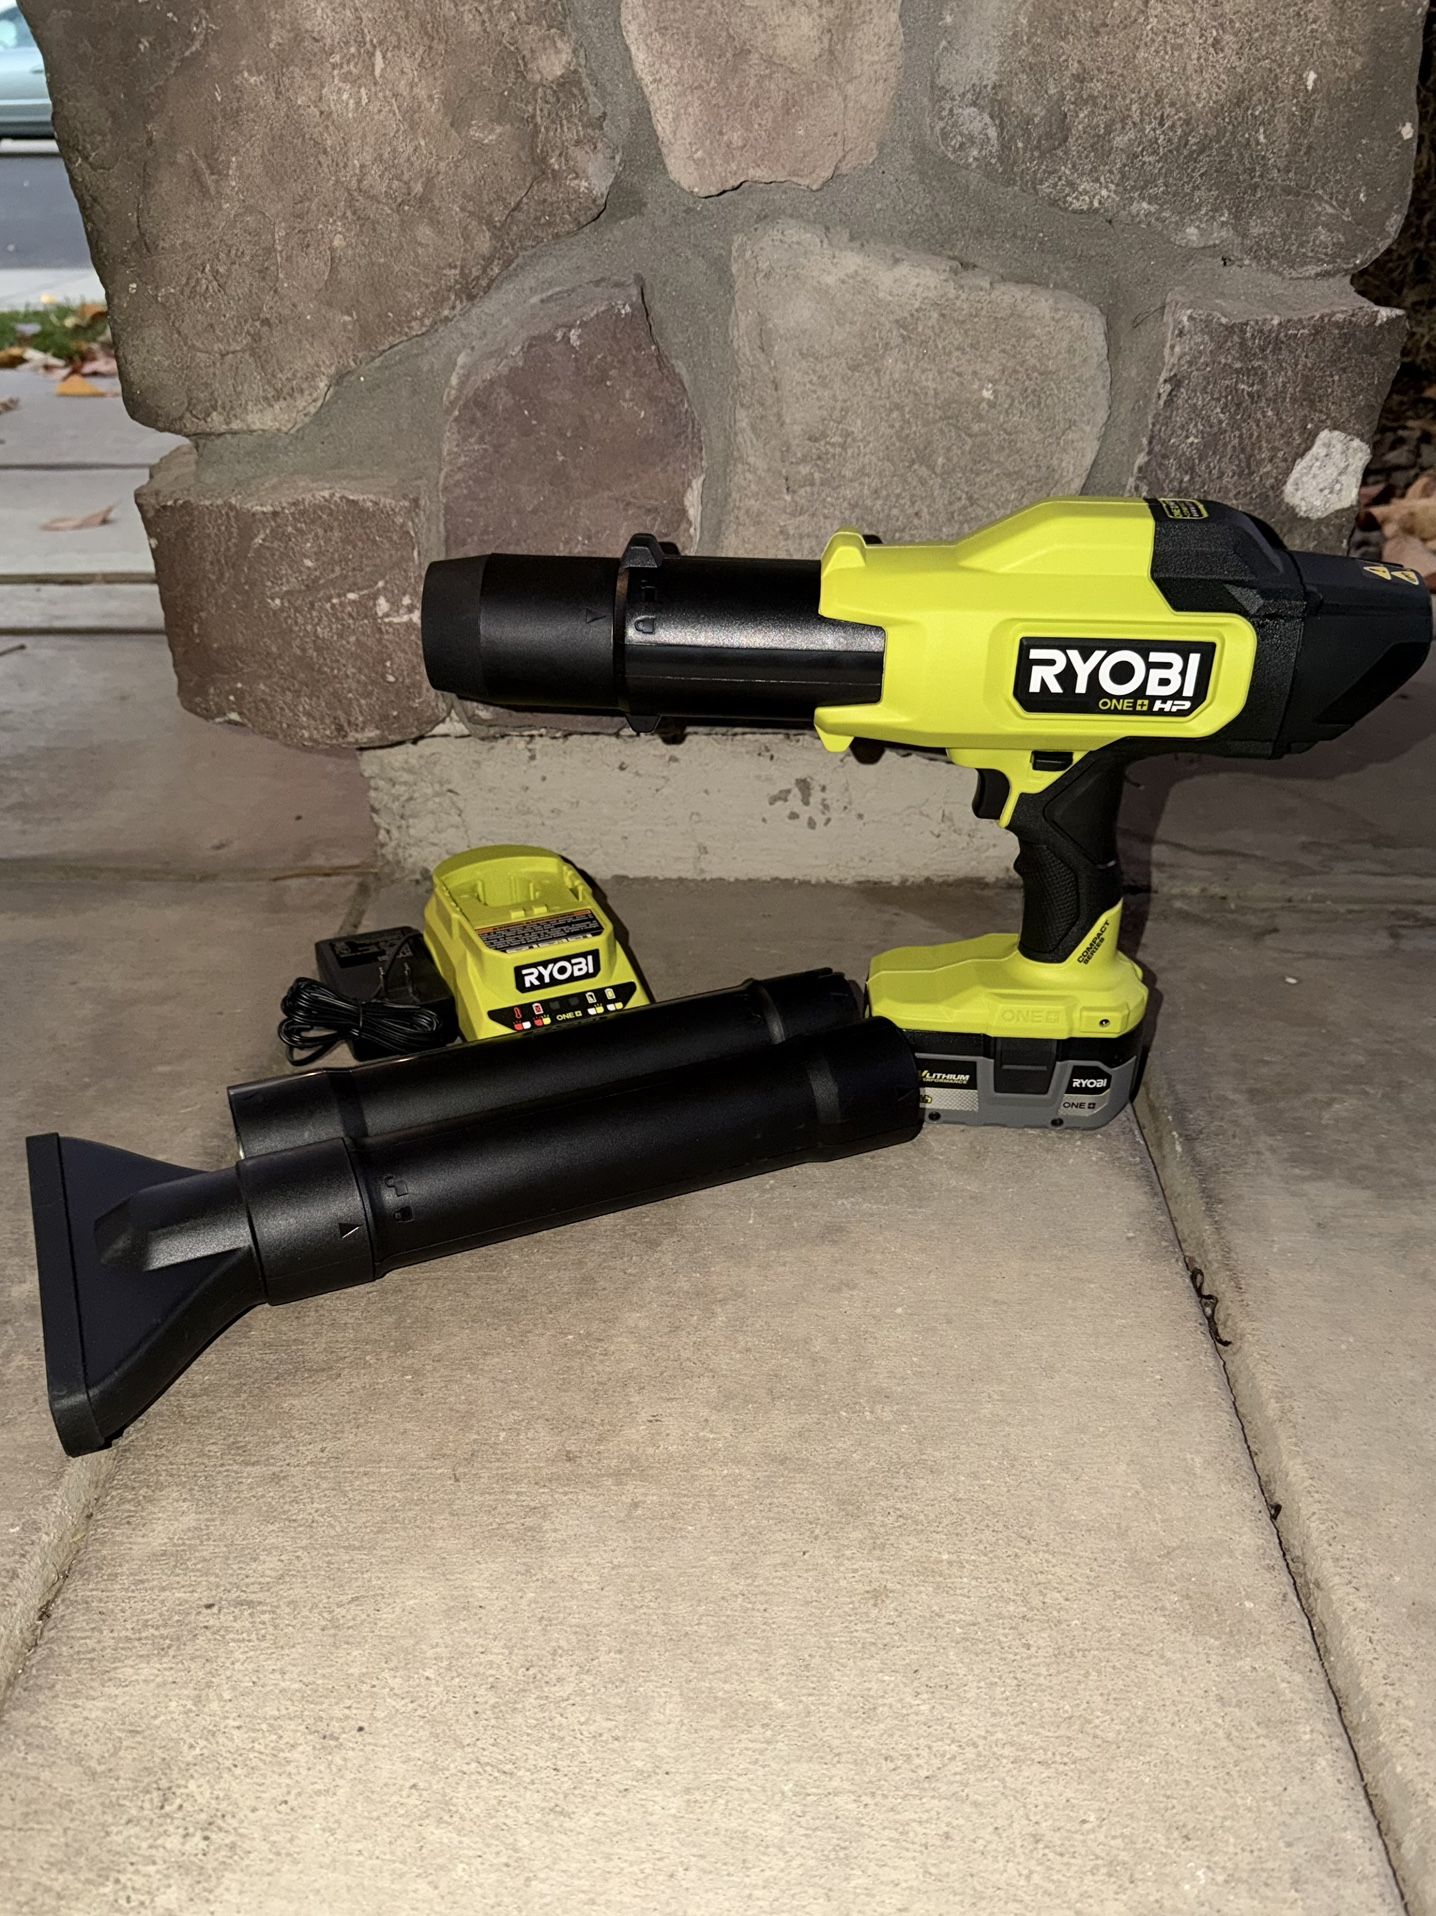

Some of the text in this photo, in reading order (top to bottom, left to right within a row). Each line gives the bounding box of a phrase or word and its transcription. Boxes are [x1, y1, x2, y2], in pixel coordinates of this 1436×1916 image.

[1028, 648, 1201, 697] RYOBI
[1152, 699, 1192, 712] HP
[1077, 920, 1110, 964] COMPACT
[1083, 937, 1105, 965] SERIES
[521, 955, 594, 988] RYOBI
[1072, 1078, 1107, 1088] RYOBI
